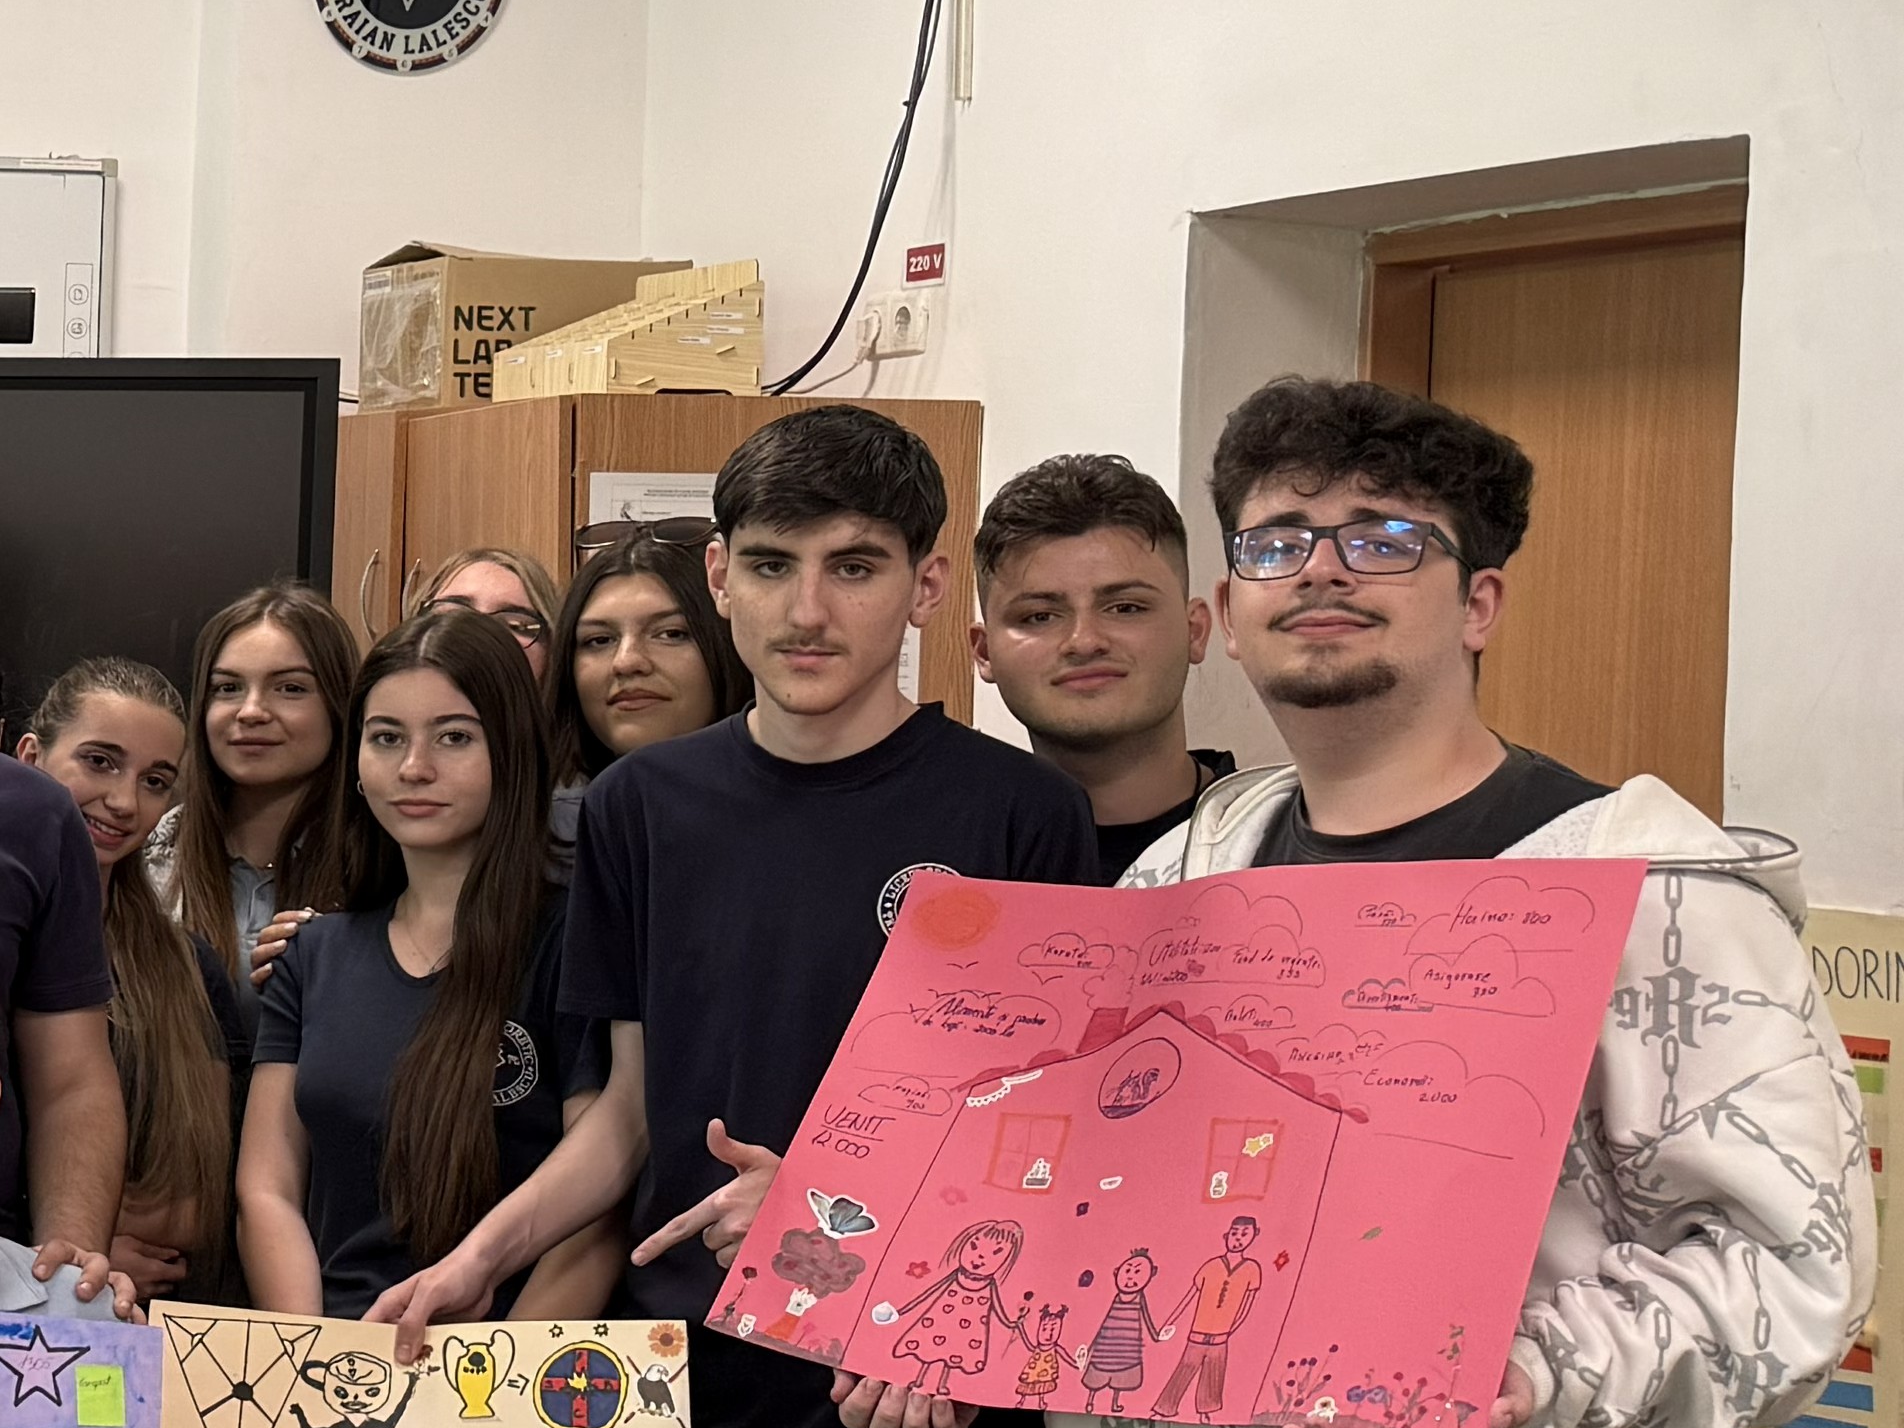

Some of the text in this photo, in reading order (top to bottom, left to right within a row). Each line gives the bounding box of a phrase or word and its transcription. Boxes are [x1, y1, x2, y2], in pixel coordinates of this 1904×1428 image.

[909, 253, 942, 273] 220 V
[454, 305, 537, 332] NEXT
[453, 372, 492, 398] TE
[824, 1104, 896, 1135] VENIT
